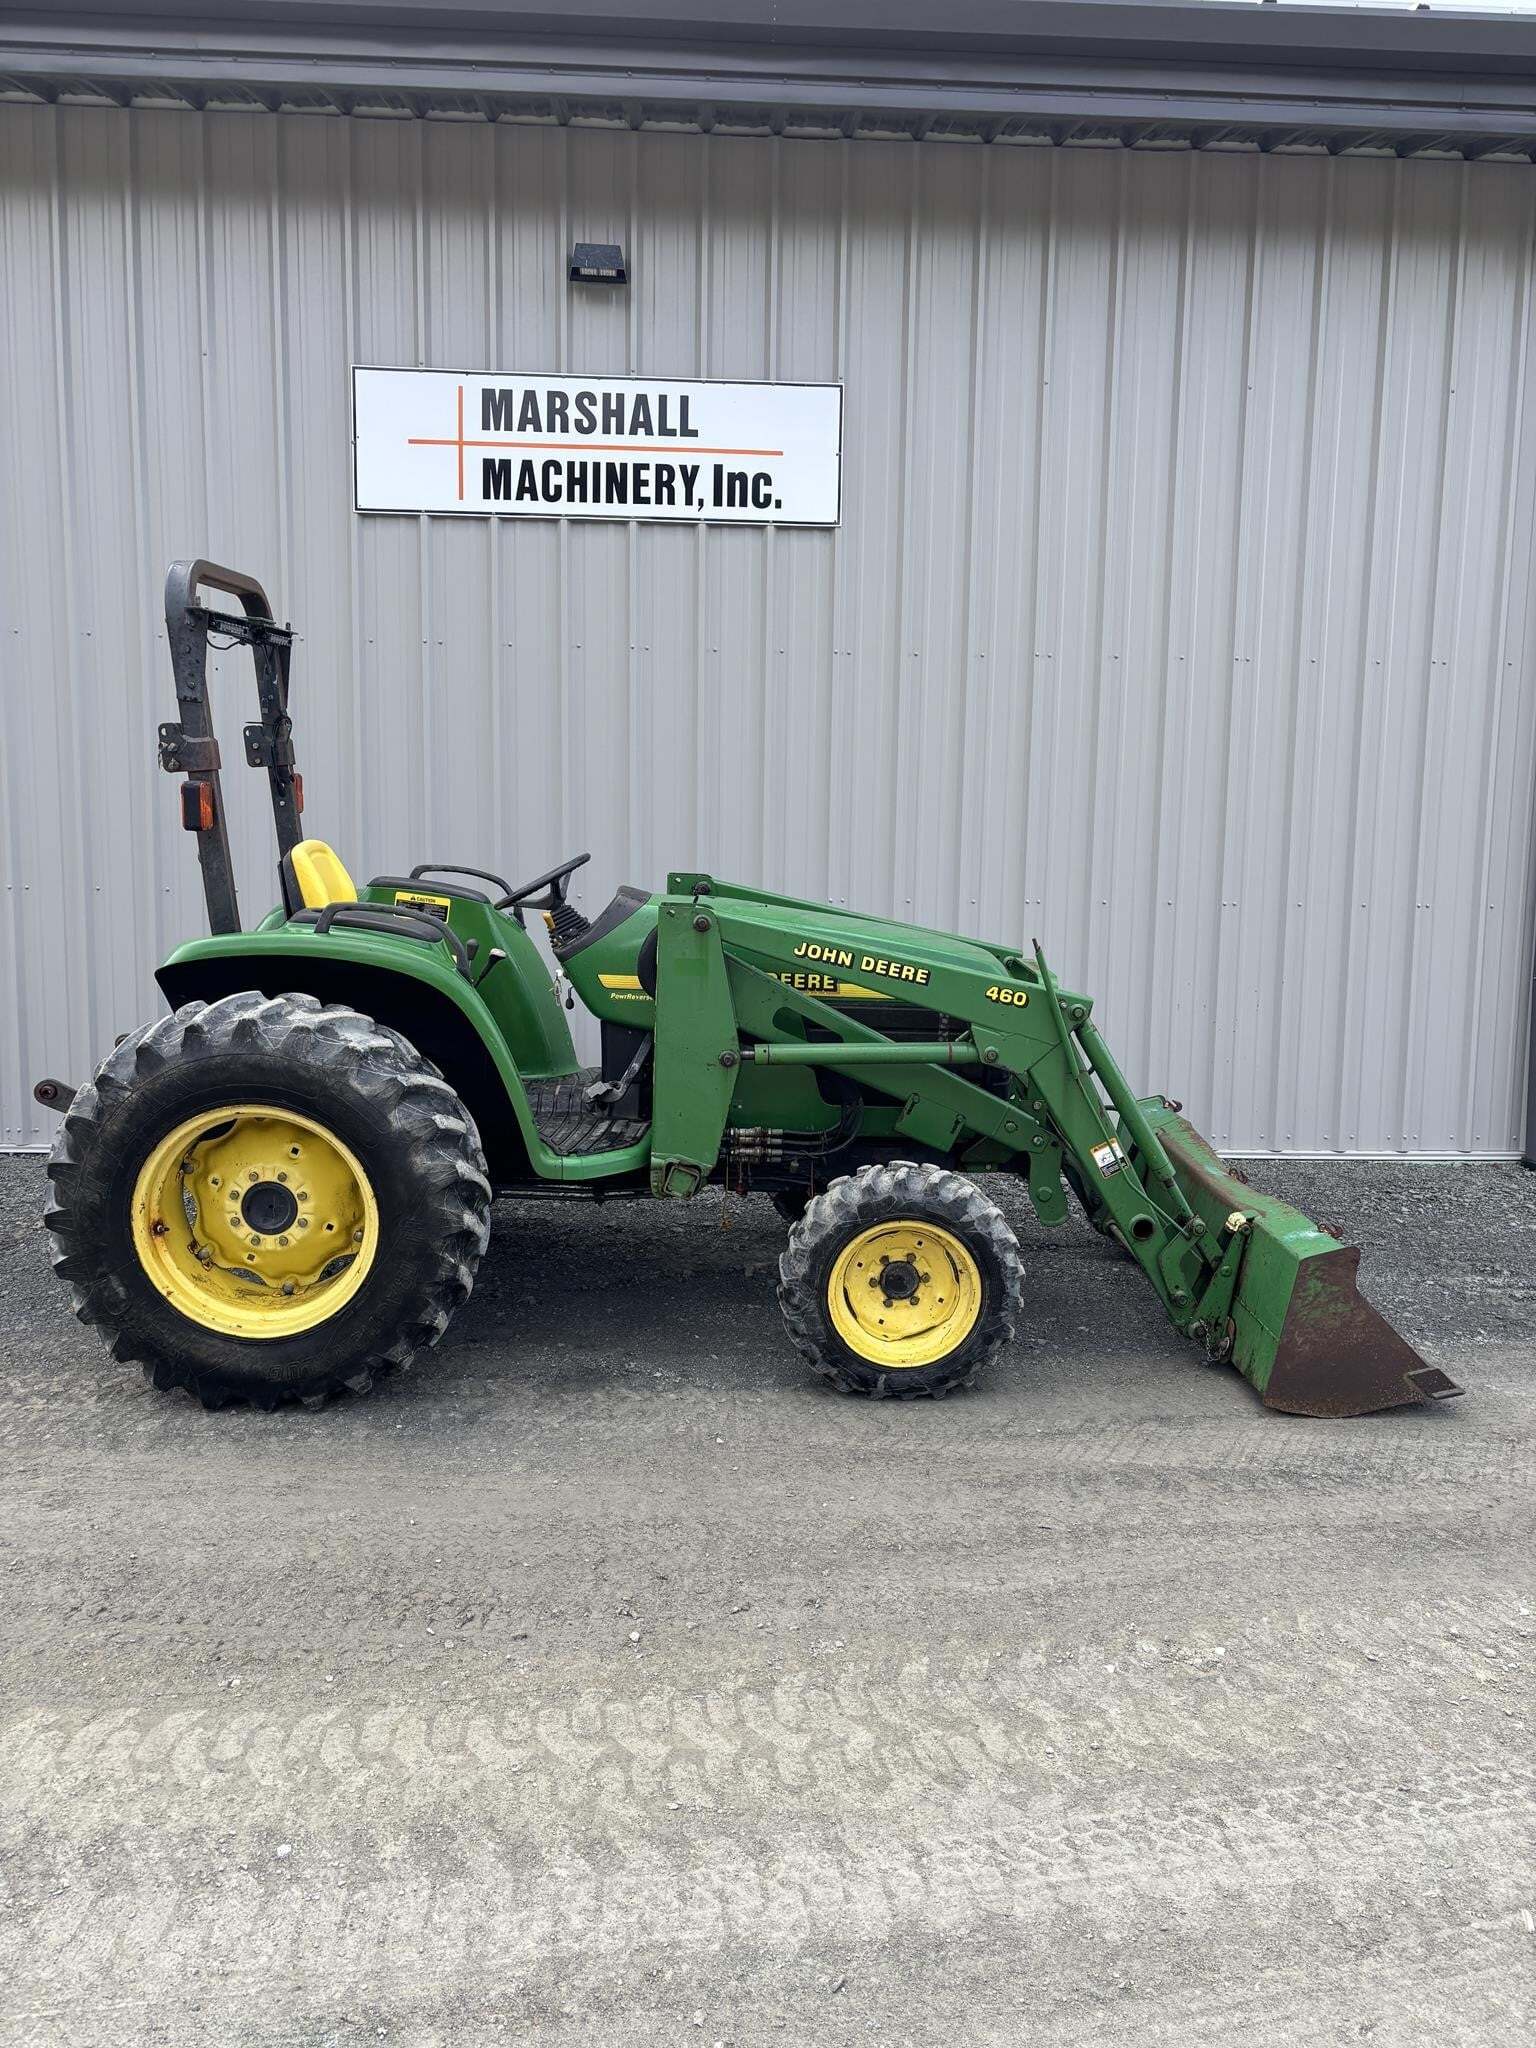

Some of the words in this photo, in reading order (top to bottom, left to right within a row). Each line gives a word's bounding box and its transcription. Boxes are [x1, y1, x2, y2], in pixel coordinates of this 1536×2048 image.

[481, 388, 699, 437] MARSHALL
[482, 458, 704, 511] MACHINERY,
[713, 464, 782, 509] Inc.
[793, 942, 853, 967] JOHN
[860, 955, 930, 985] DEERE
[985, 986, 1027, 1006] 460
